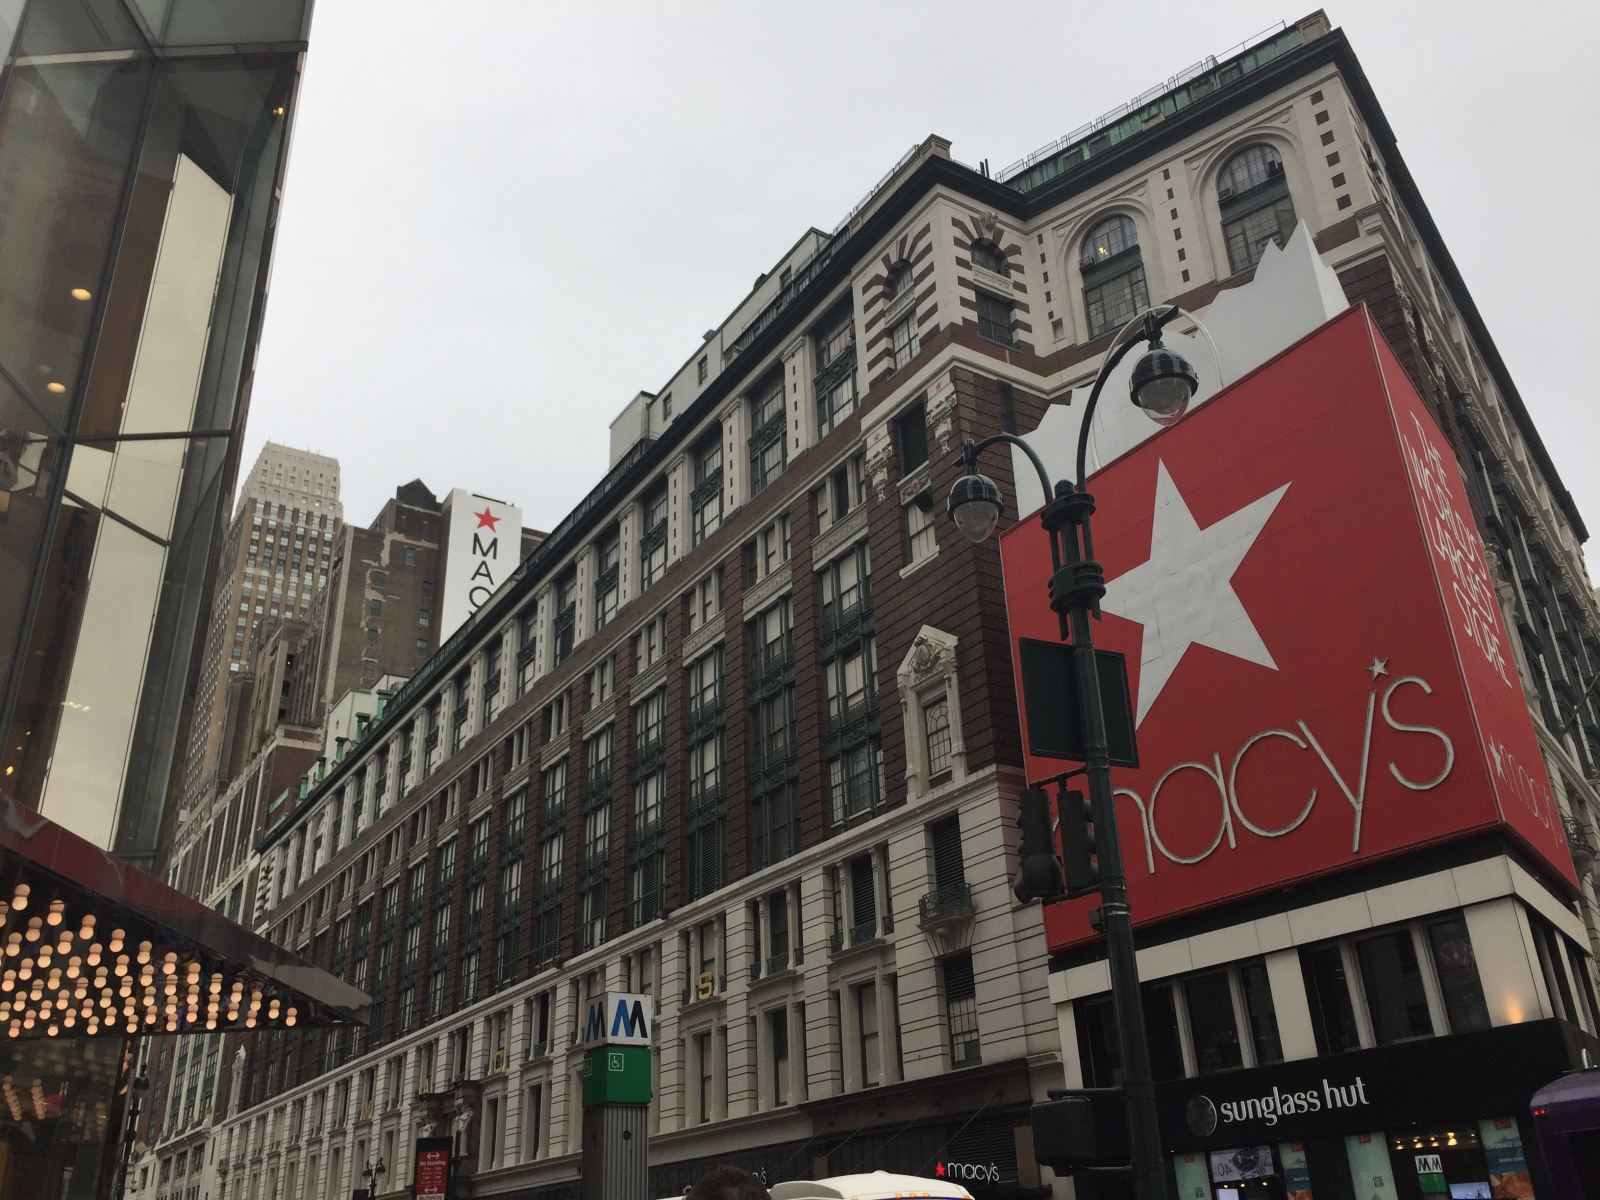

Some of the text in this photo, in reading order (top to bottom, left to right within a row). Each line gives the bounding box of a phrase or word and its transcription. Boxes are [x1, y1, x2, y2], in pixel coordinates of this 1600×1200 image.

[1410, 410, 1453, 500] THE
[1404, 434, 1487, 581] WORLD'S
[467, 532, 498, 619] MAC
[1421, 496, 1500, 635] LARGEST
[1453, 581, 1513, 689] STORE
[1220, 1076, 1370, 1126] sunglass hut
[947, 1161, 1000, 1185] macy's
